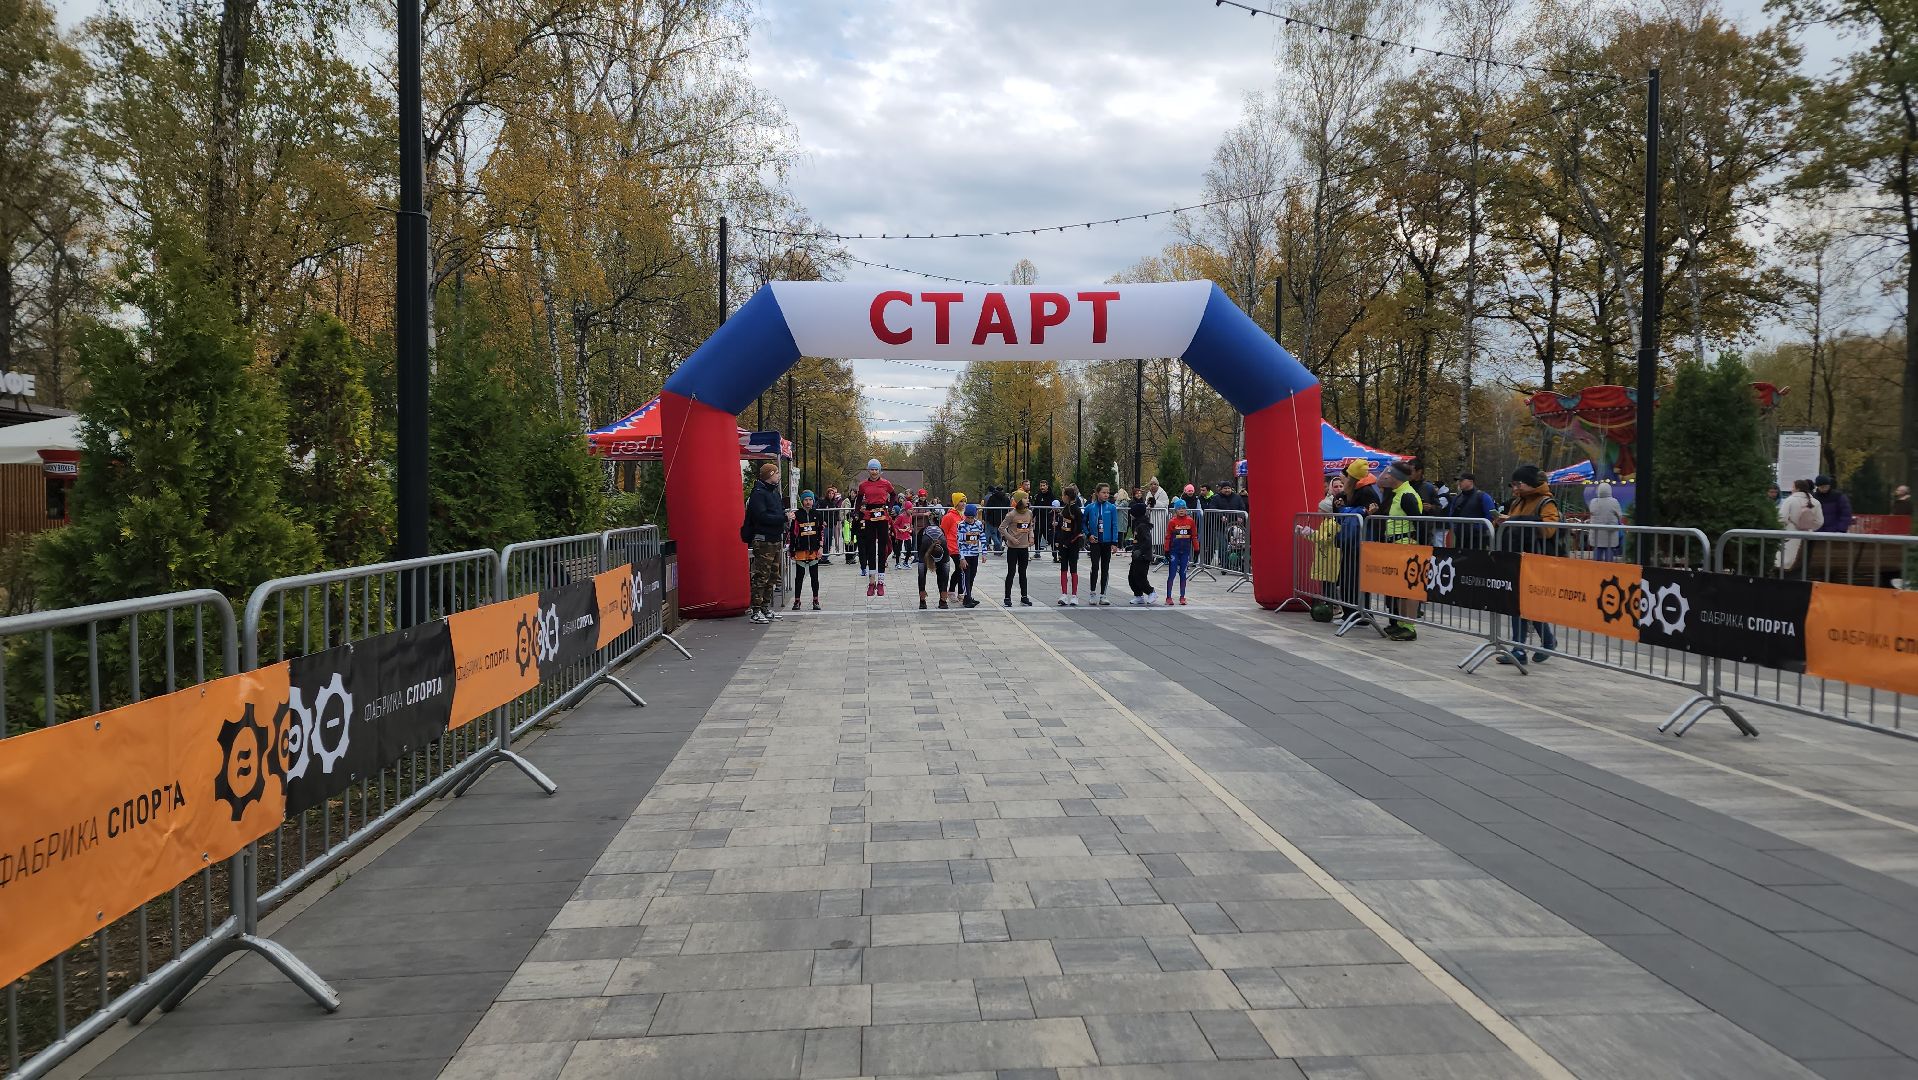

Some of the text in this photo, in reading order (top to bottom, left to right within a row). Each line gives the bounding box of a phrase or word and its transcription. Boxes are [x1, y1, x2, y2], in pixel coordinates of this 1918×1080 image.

[869, 290, 1120, 345] СТАРТ
[1486, 578, 1513, 592] СПОРТА
[1558, 588, 1587, 603] СПОРТА
[1700, 610, 1796, 637] ФАБРИКА СПОРТА
[1828, 628, 1918, 656] ФАБРИКА СП
[485, 647, 510, 669] СПОРТА
[364, 676, 443, 723] ФАБРИКА СПОРТА
[0, 779, 186, 888] ФАБРИКА СПОРТА
